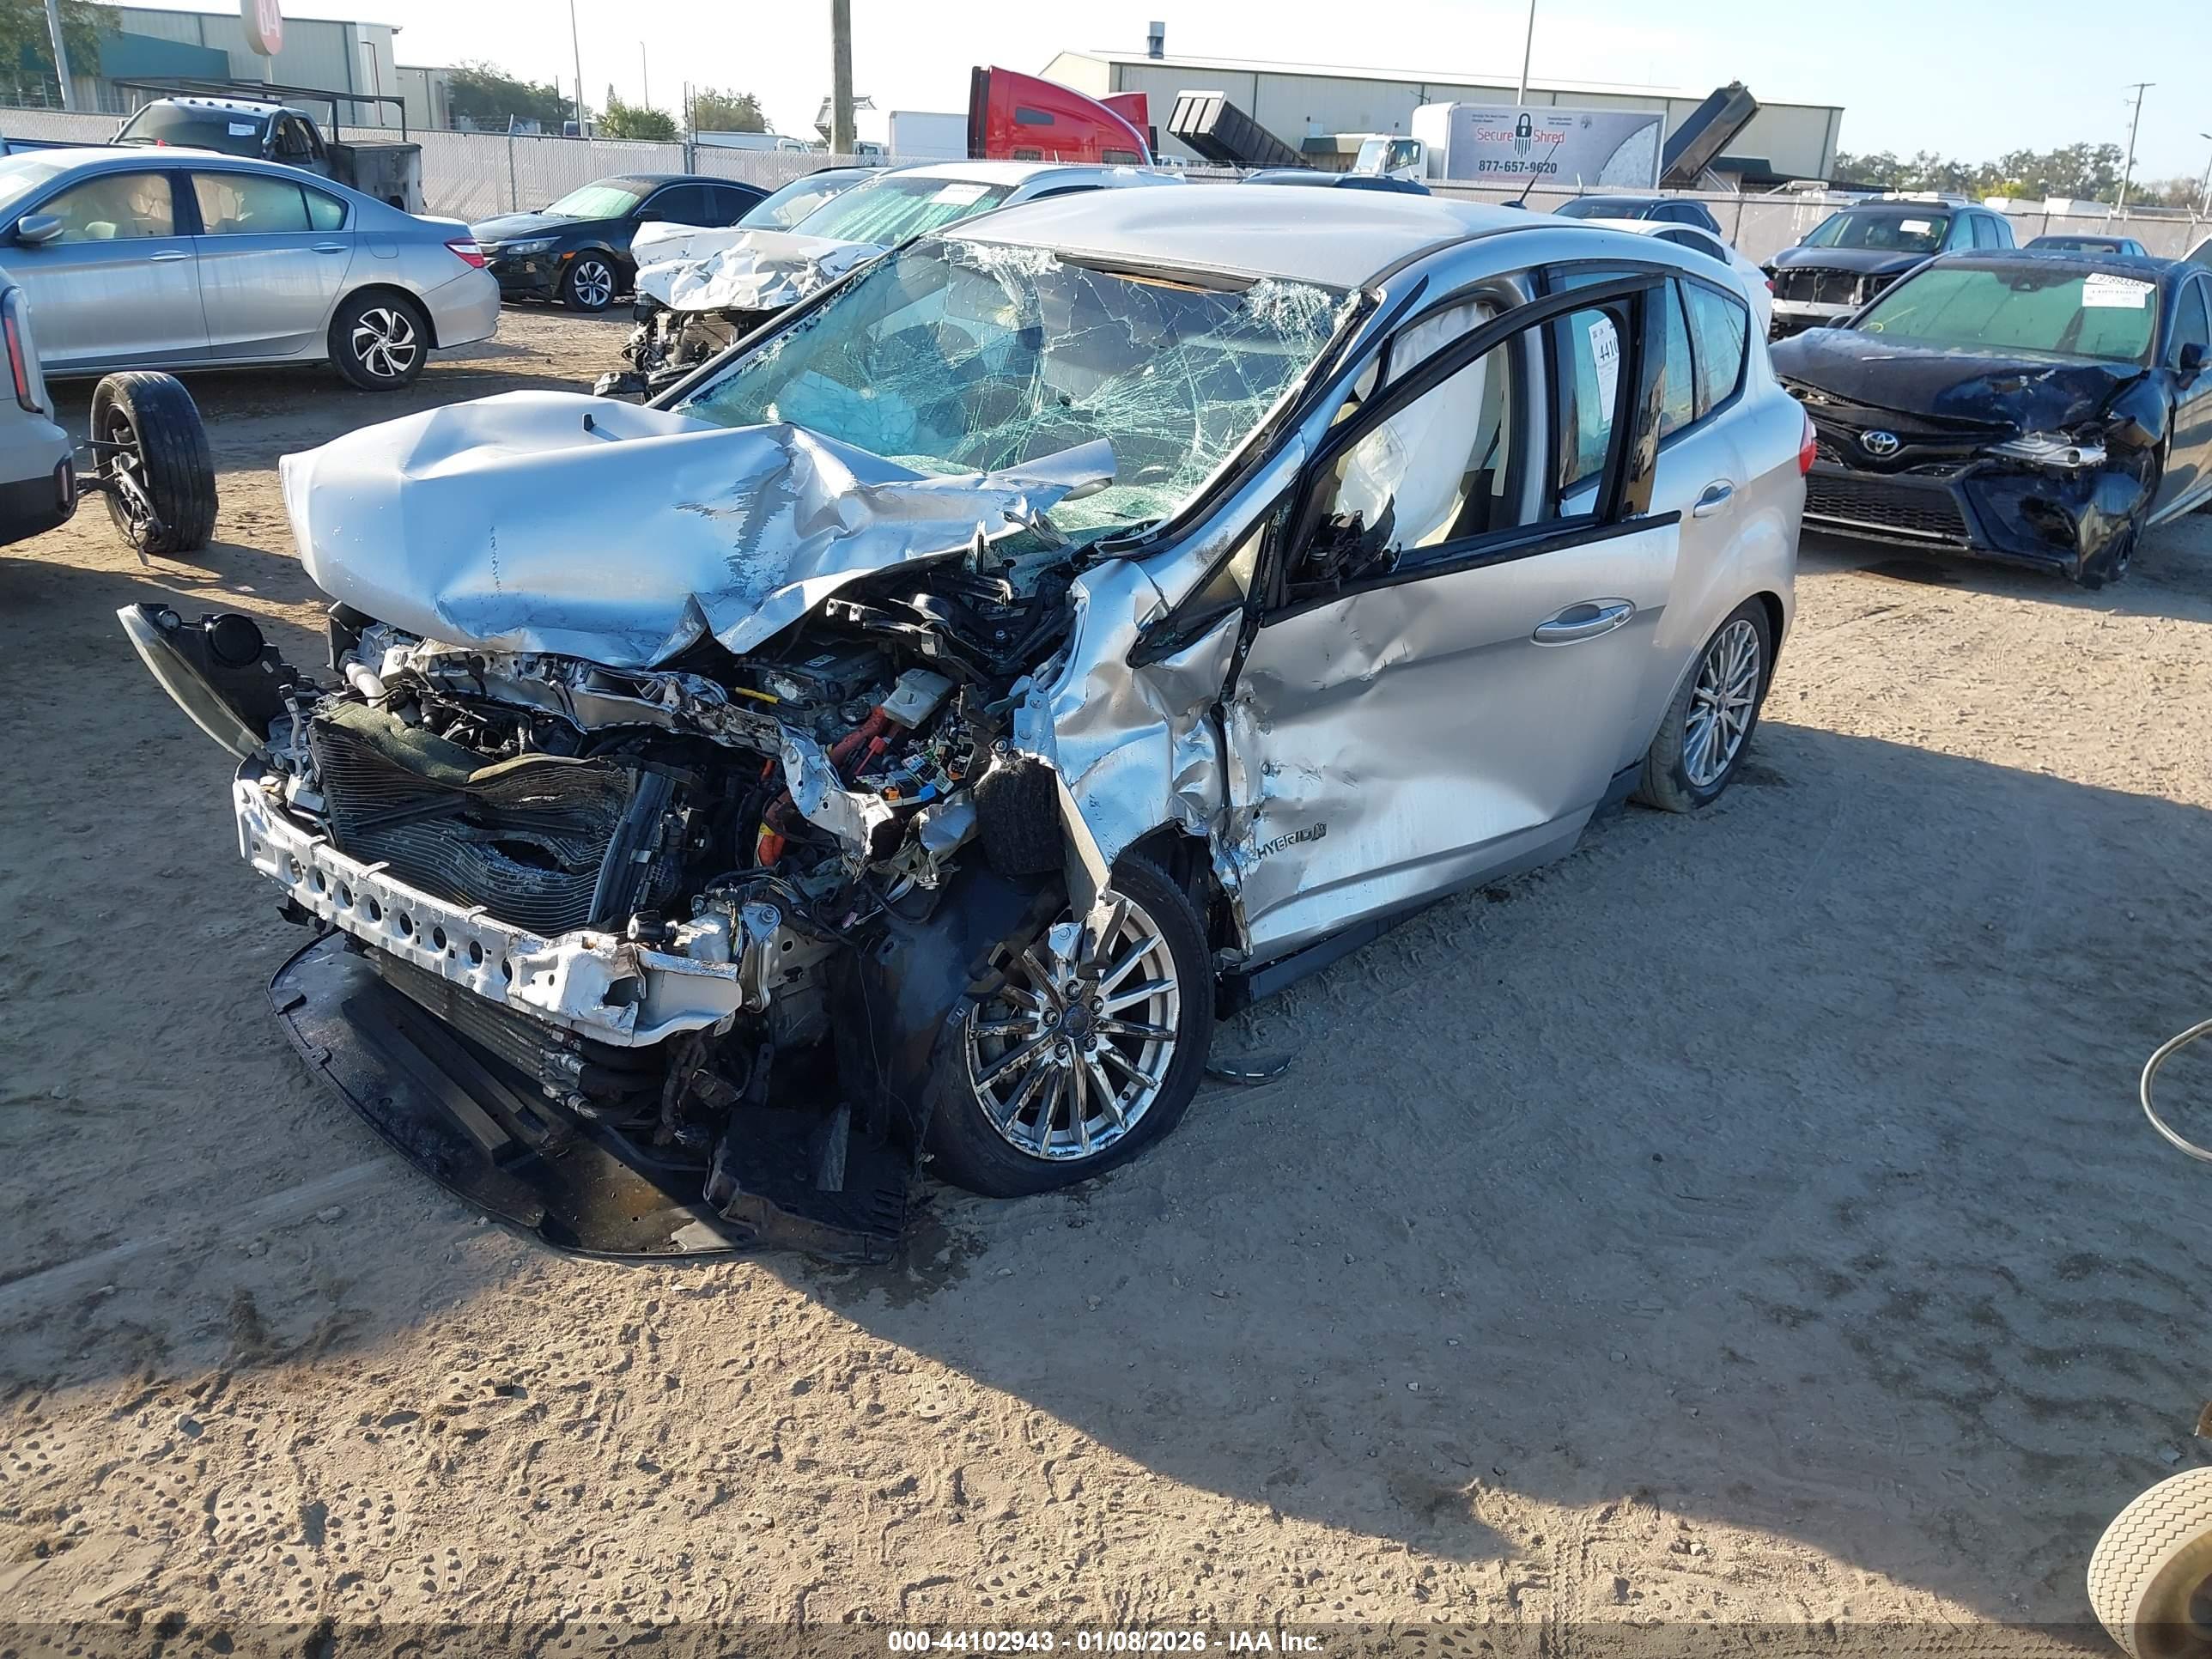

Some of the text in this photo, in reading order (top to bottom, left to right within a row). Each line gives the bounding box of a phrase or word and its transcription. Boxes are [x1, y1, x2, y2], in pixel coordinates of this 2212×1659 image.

[1477, 128, 1565, 144] Secure Shred
[1479, 160, 1558, 174] 877-657-9620
